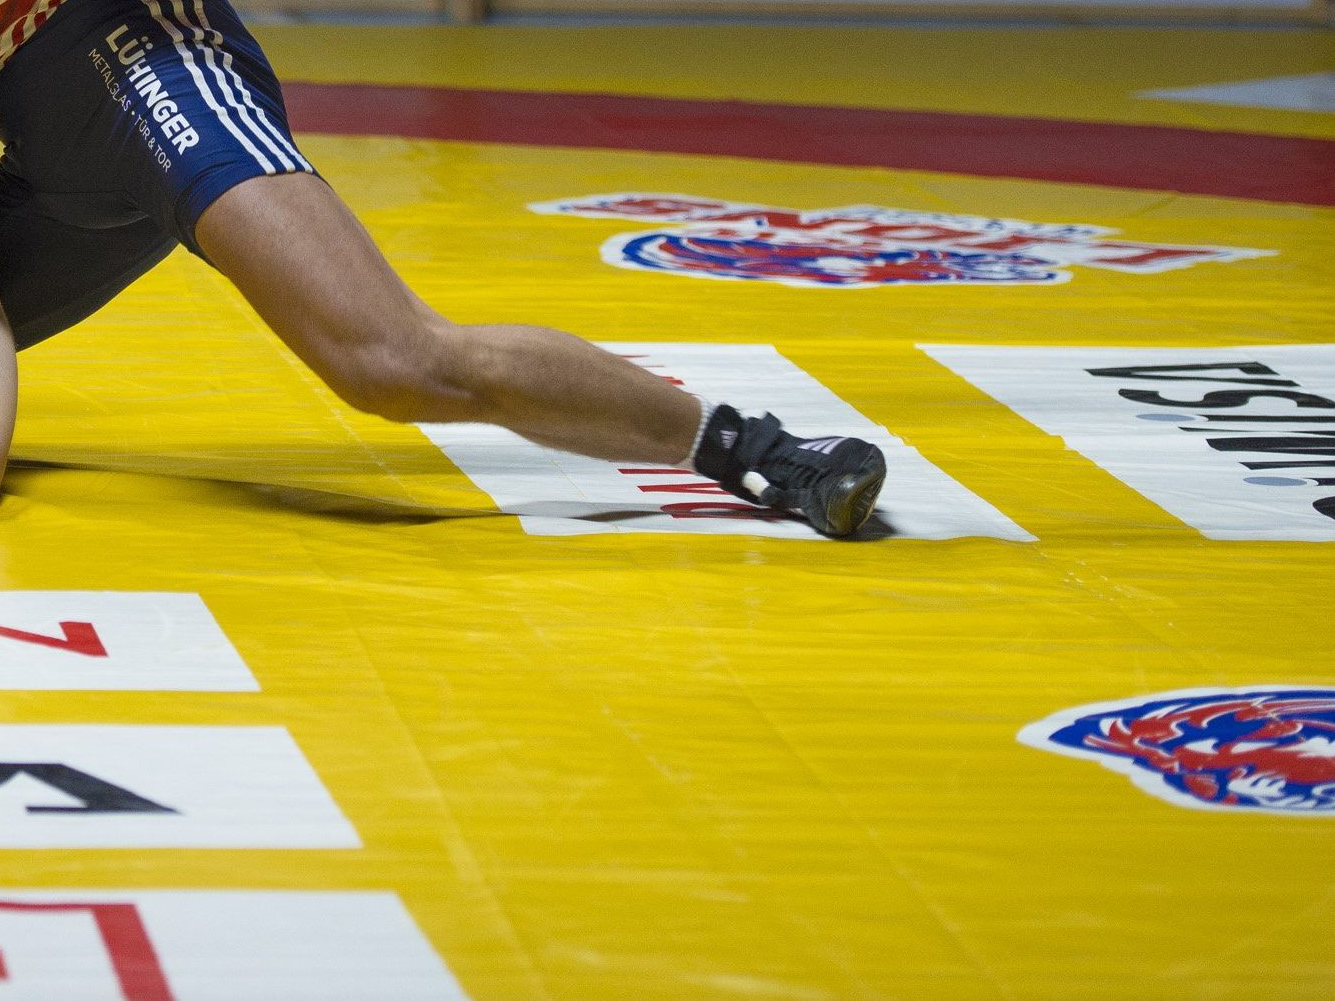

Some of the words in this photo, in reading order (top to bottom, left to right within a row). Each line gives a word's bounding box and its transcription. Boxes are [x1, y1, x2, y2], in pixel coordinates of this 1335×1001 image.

[106, 24, 199, 155] LÜHINGER
[134, 114, 151, 141] TÜR
[154, 144, 172, 172] TOR
